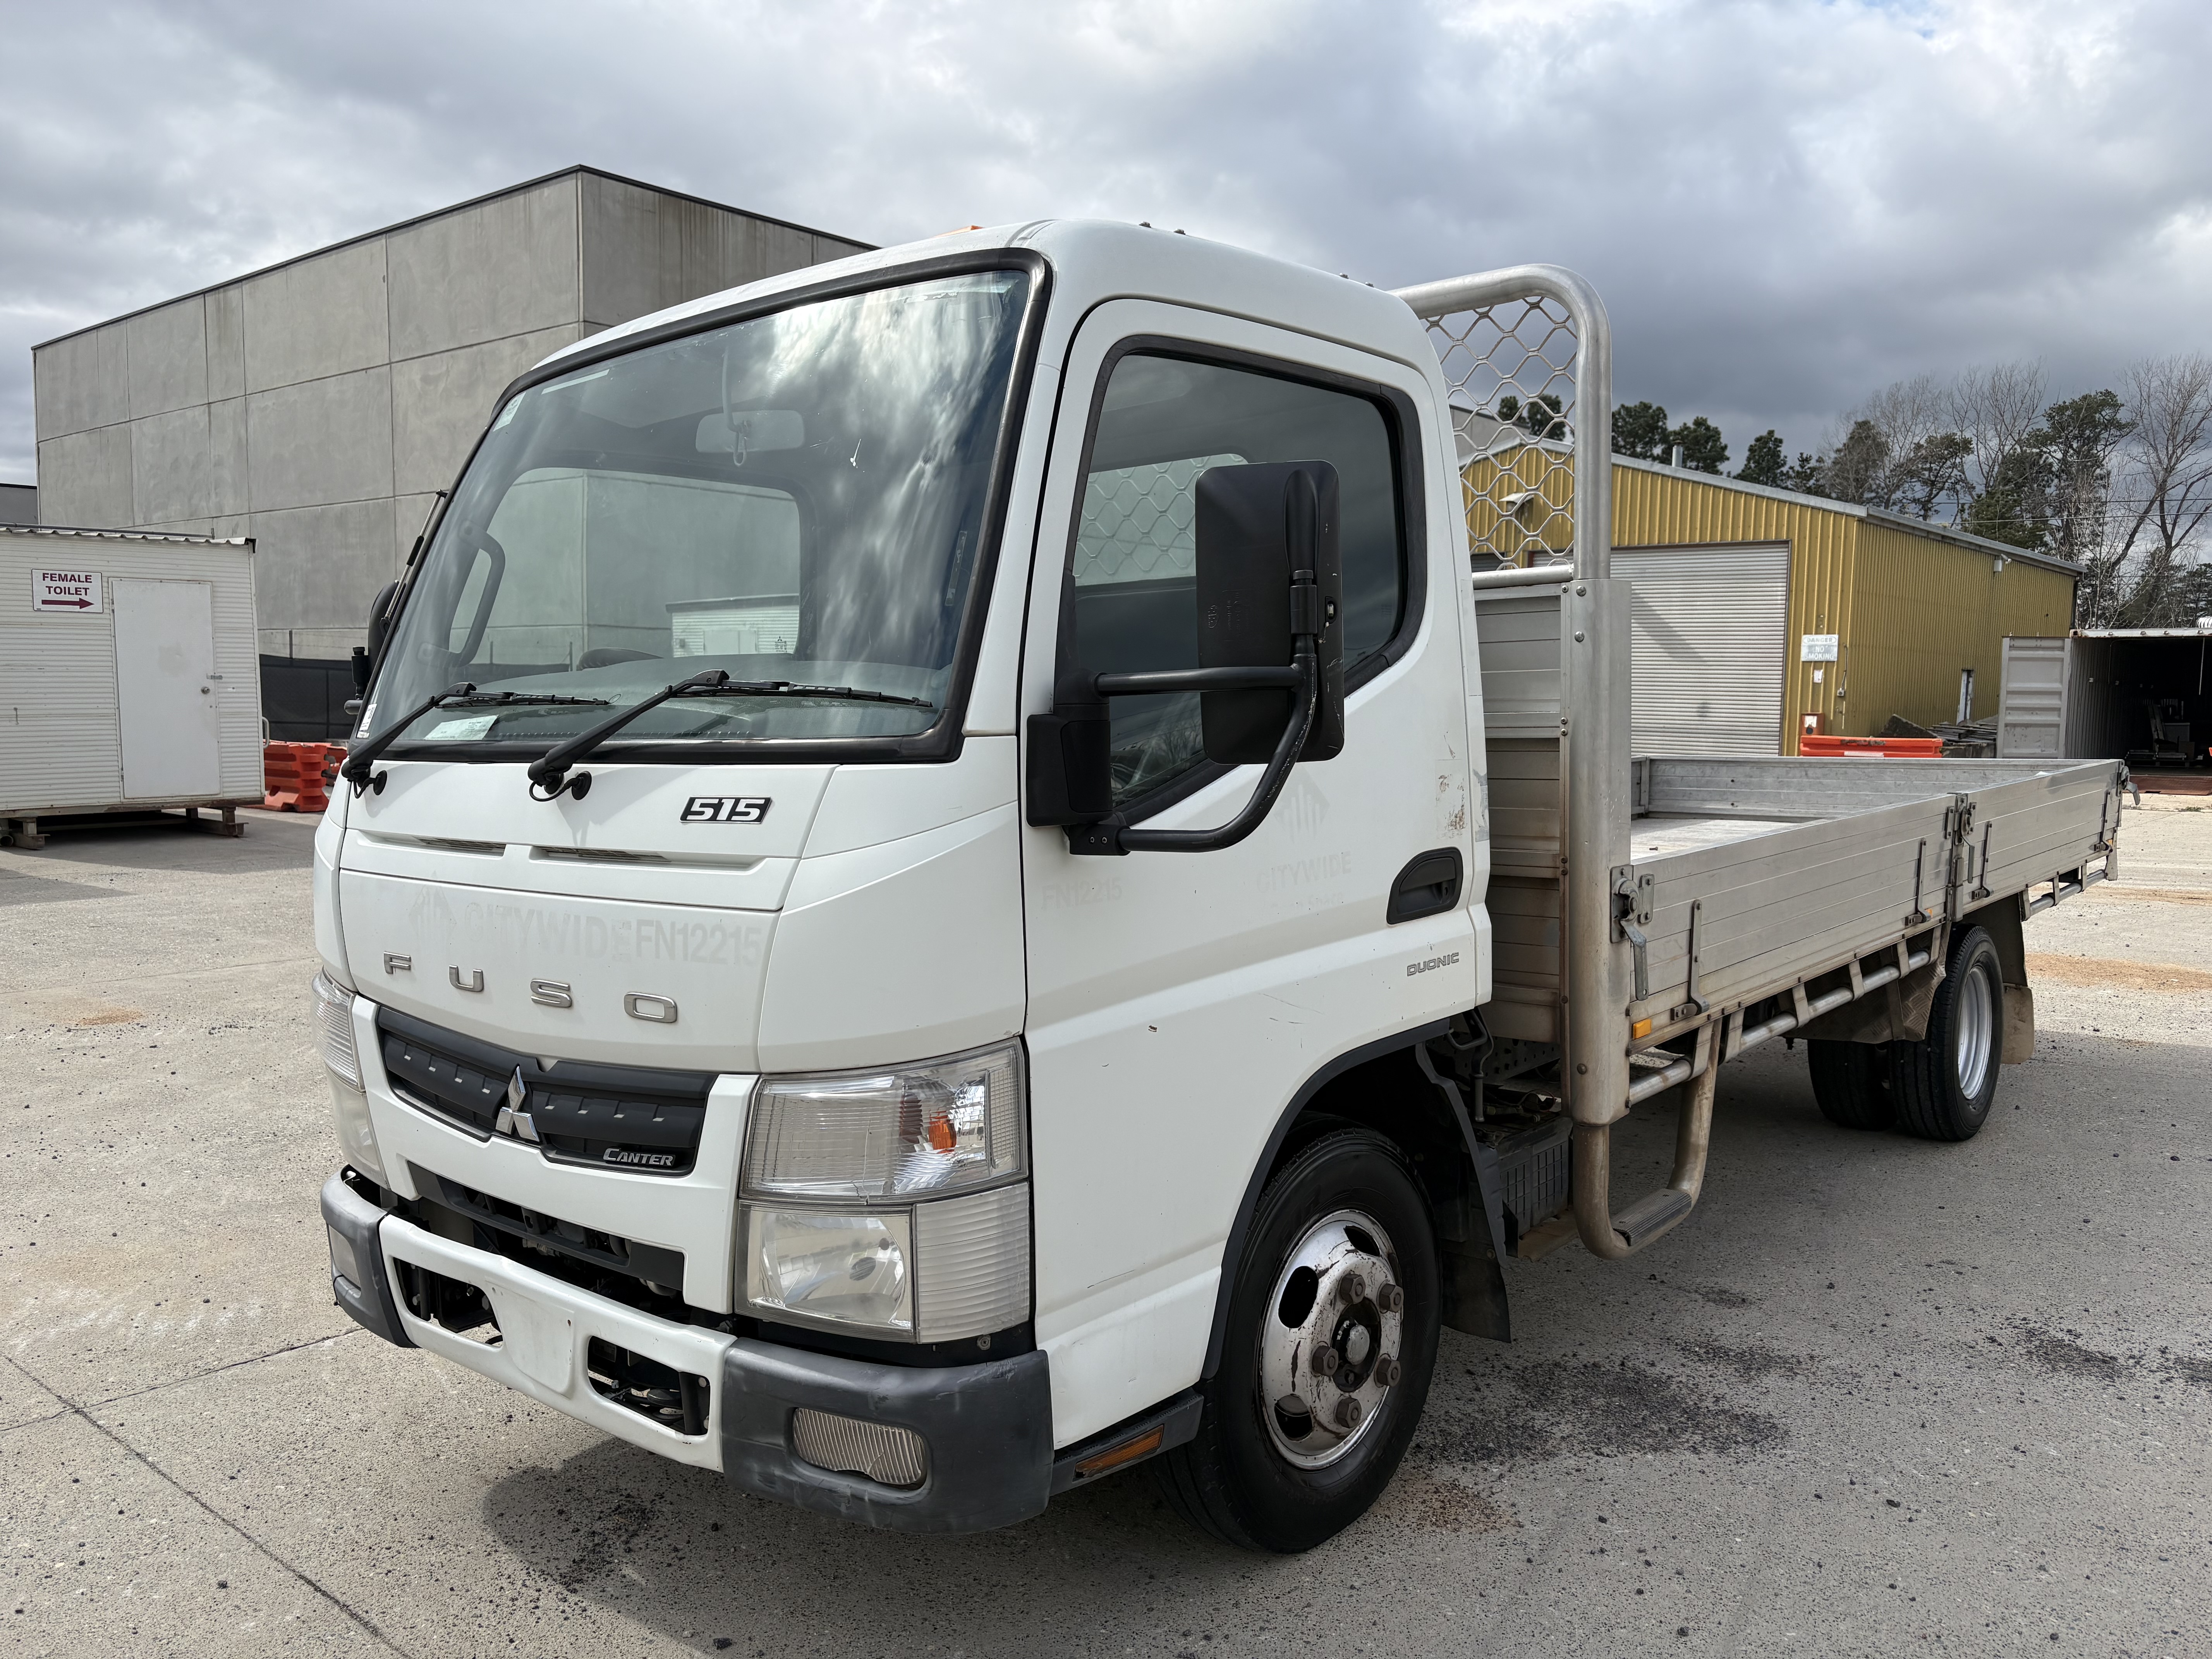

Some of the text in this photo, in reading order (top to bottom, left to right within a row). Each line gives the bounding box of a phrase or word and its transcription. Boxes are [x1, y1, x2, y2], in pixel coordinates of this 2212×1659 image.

[43, 573, 92, 583] FEMALE
[45, 586, 89, 596] TOILET
[686, 799, 765, 821] 515
[1257, 851, 1352, 893] CITYWIDE
[1407, 952, 1459, 977] DUONIC
[384, 951, 678, 1023] FUSO
